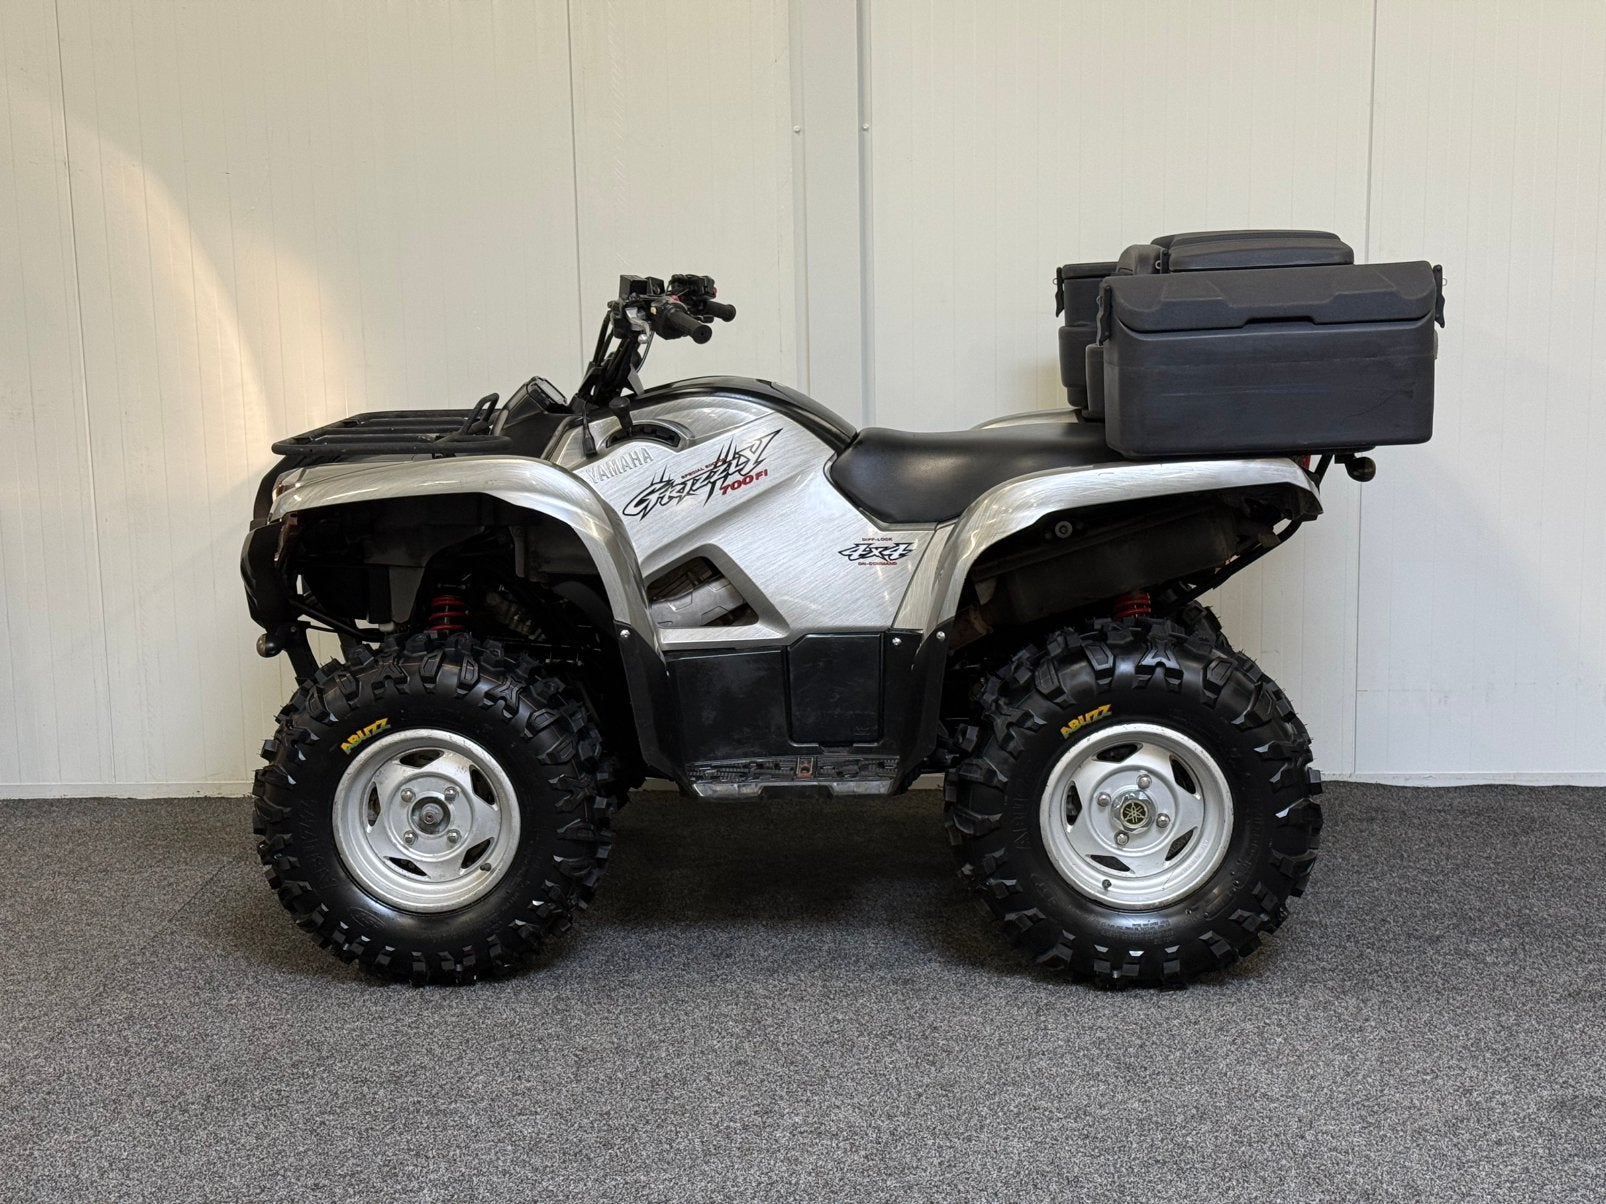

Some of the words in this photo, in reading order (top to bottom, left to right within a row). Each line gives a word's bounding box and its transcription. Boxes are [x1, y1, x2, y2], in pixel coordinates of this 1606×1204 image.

[586, 447, 654, 484] YAMAHA
[340, 717, 391, 755] ABUZZ
[1060, 704, 1112, 739] ABUZZ
